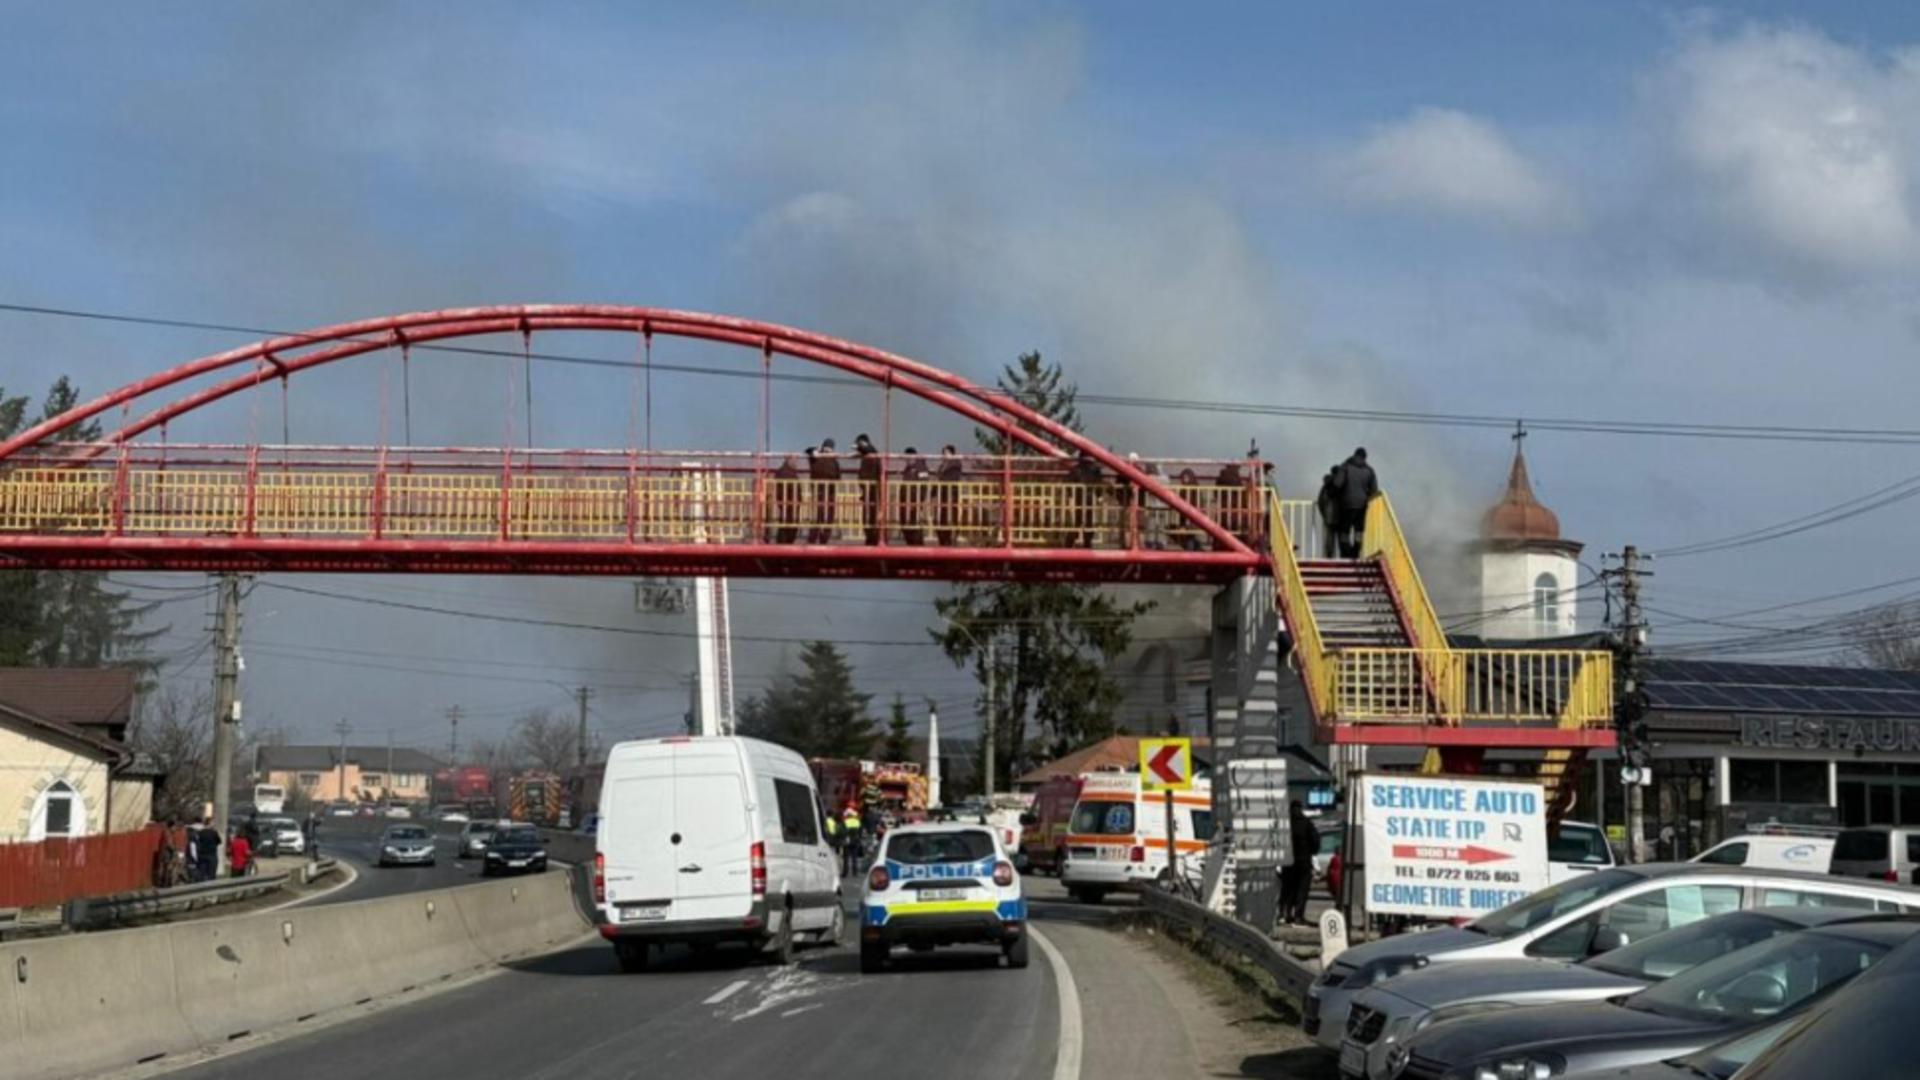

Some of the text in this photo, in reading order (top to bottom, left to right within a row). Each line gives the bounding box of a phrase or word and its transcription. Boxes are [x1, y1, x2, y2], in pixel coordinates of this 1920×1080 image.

[1372, 785, 1536, 815] SERVICE AUTO
[1386, 816, 1486, 840] STATIE ITP
[1426, 867, 1461, 880] 0722
[1372, 883, 1465, 908] GEOMETRIE
